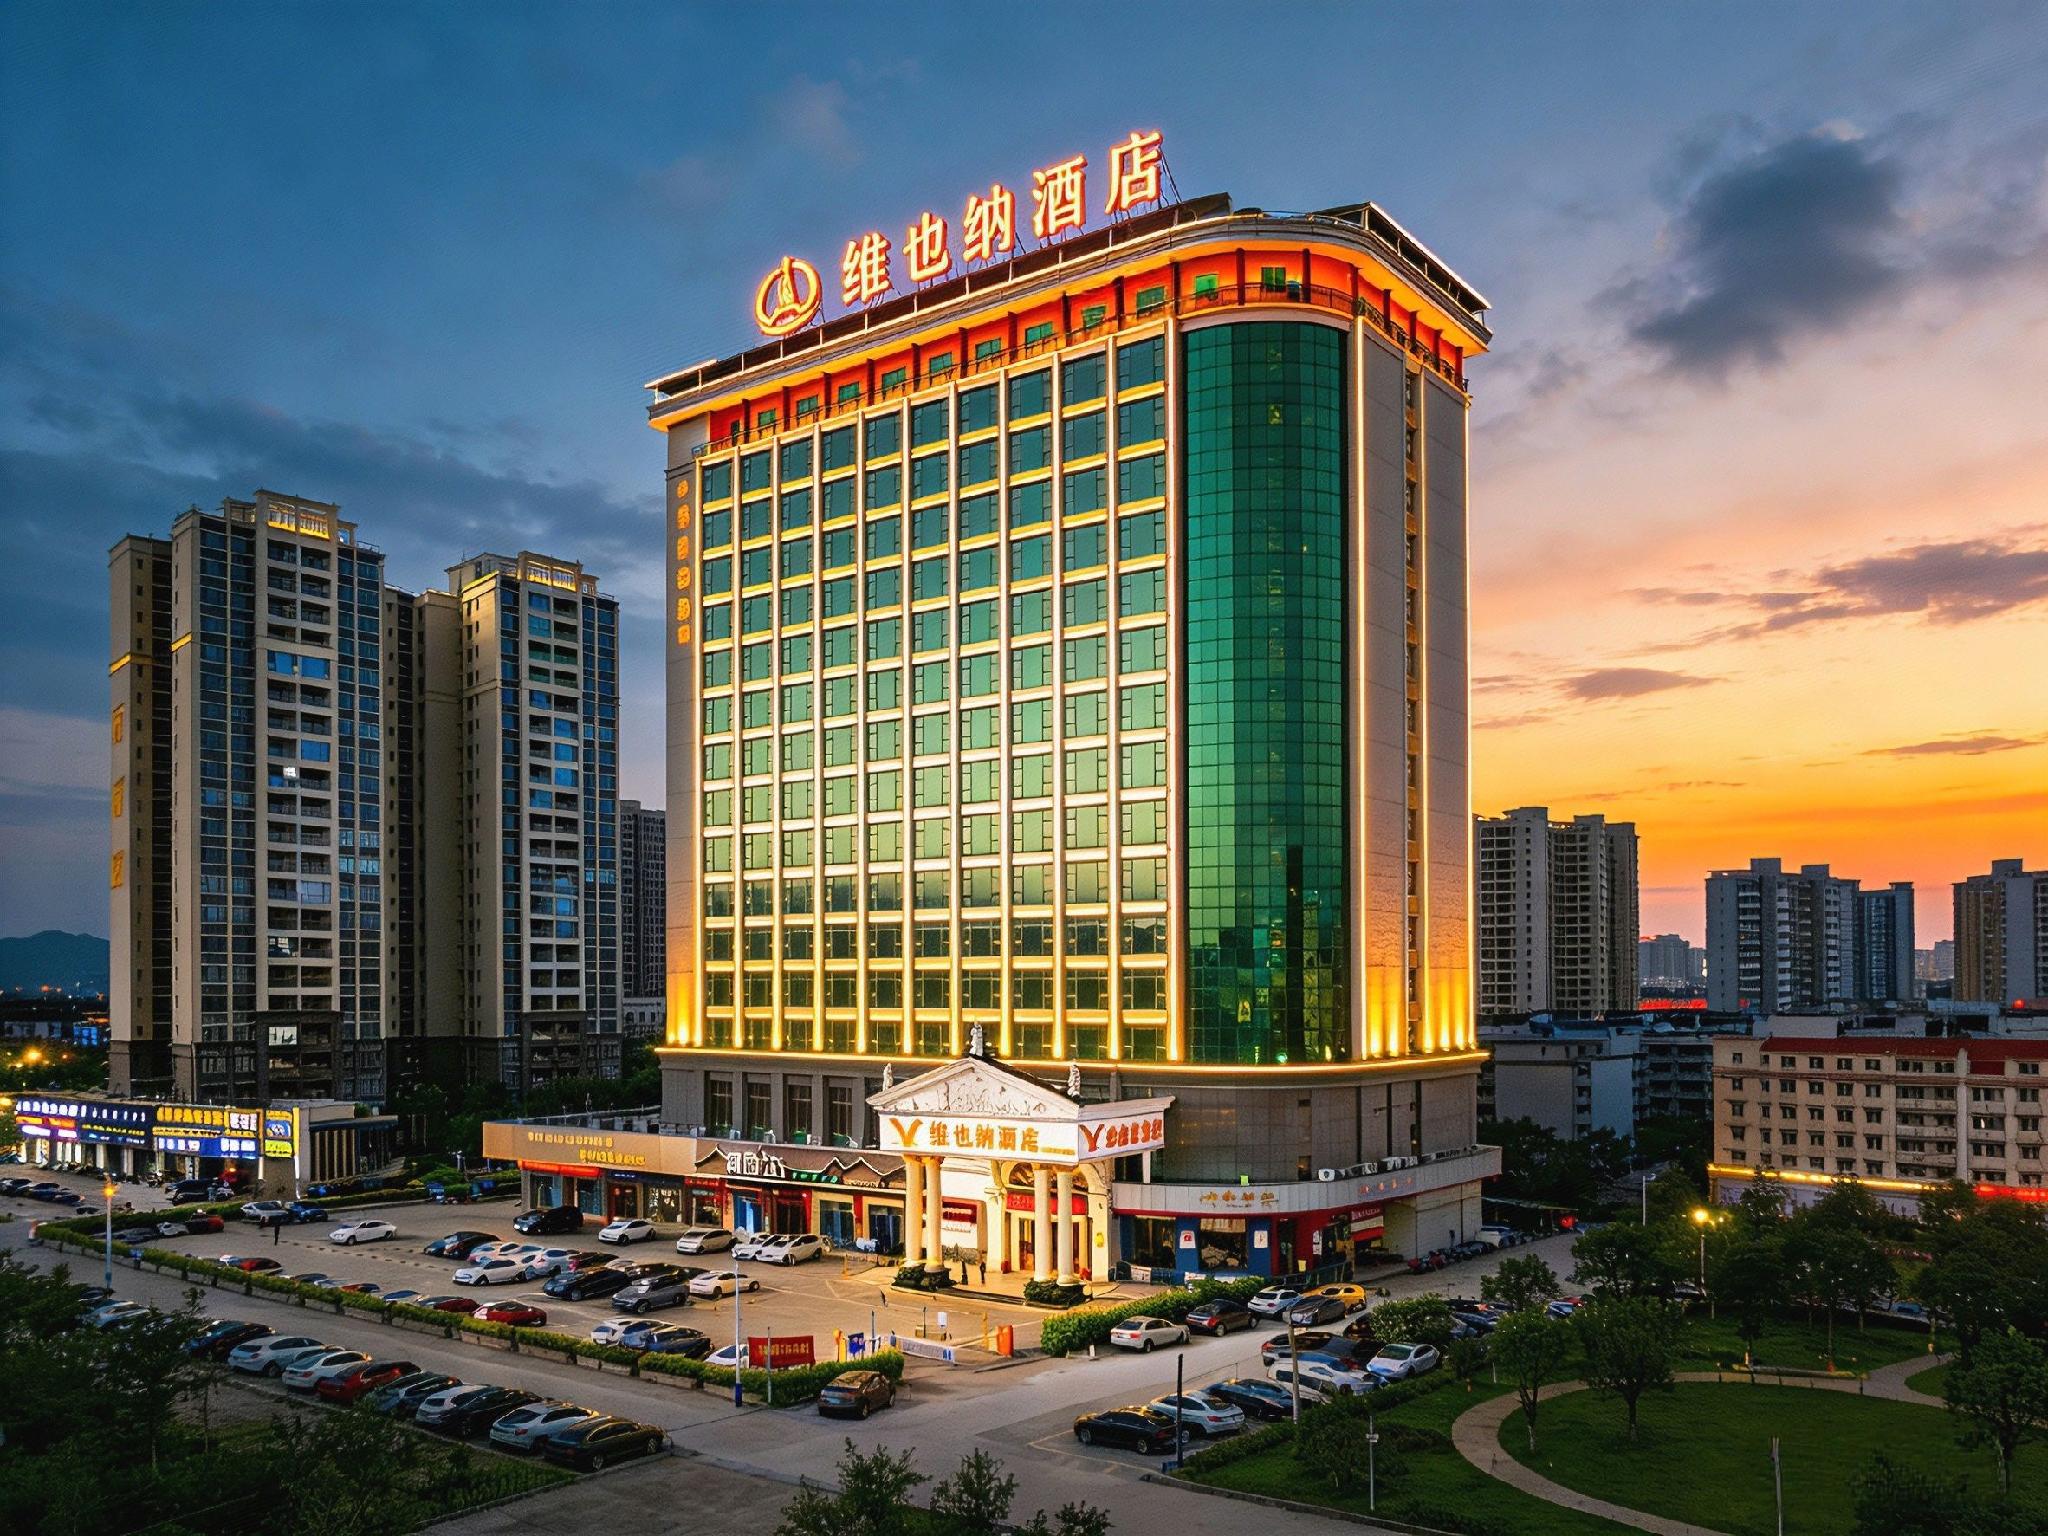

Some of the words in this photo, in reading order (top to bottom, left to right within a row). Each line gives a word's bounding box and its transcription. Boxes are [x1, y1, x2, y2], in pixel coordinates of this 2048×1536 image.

[842, 130, 1163, 306] 维也纳酒店
